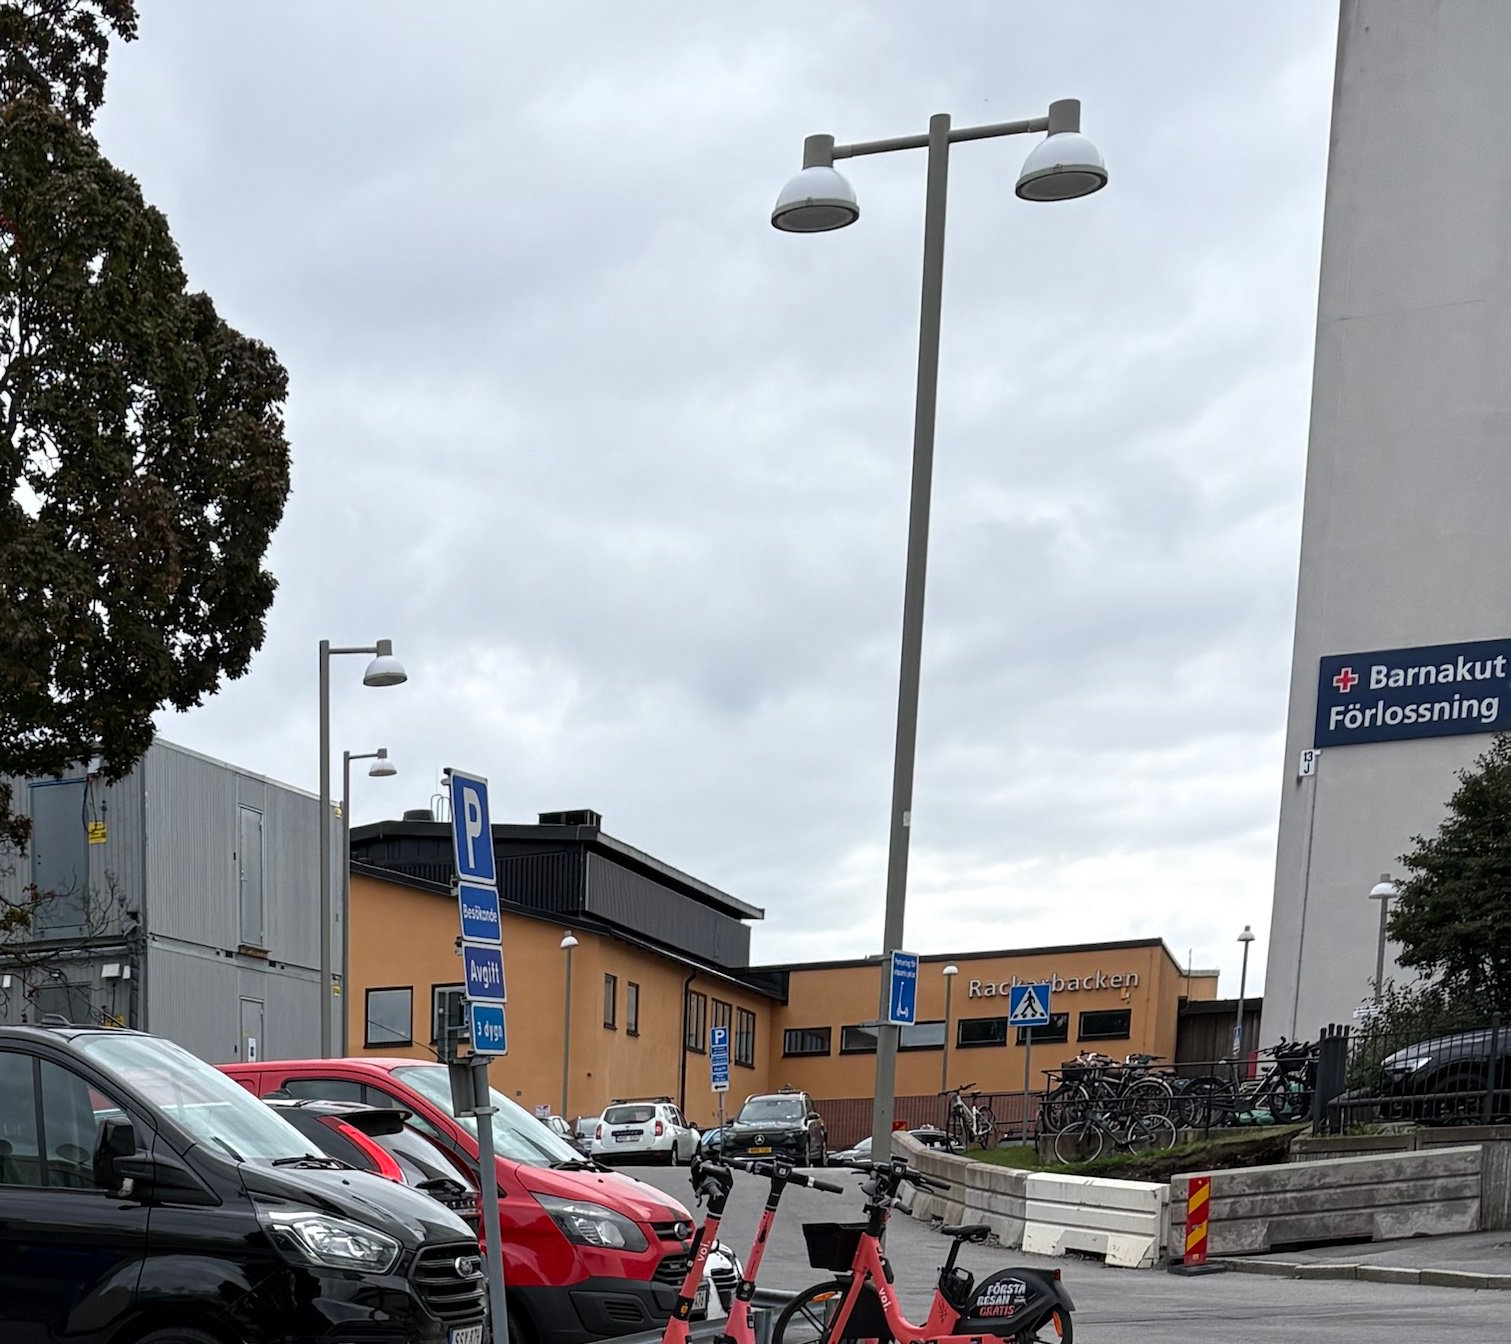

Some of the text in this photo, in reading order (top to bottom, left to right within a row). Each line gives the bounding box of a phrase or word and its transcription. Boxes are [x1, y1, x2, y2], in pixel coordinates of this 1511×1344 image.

[1369, 654, 1507, 690] Barnakut
[1328, 693, 1500, 731] Förlossning
[1303, 750, 1314, 762] 13
[1303, 763, 1310, 774] J
[463, 786, 483, 869] P
[462, 903, 498, 923] Besökande
[470, 959, 500, 989] Avgift
[477, 1020, 503, 1042] 3 dygn
[715, 1029, 725, 1044] P
[987, 1281, 1027, 1296] FÖRSTA
[976, 1294, 1011, 1307] RESAN
[979, 1305, 1016, 1317] GRATIS
